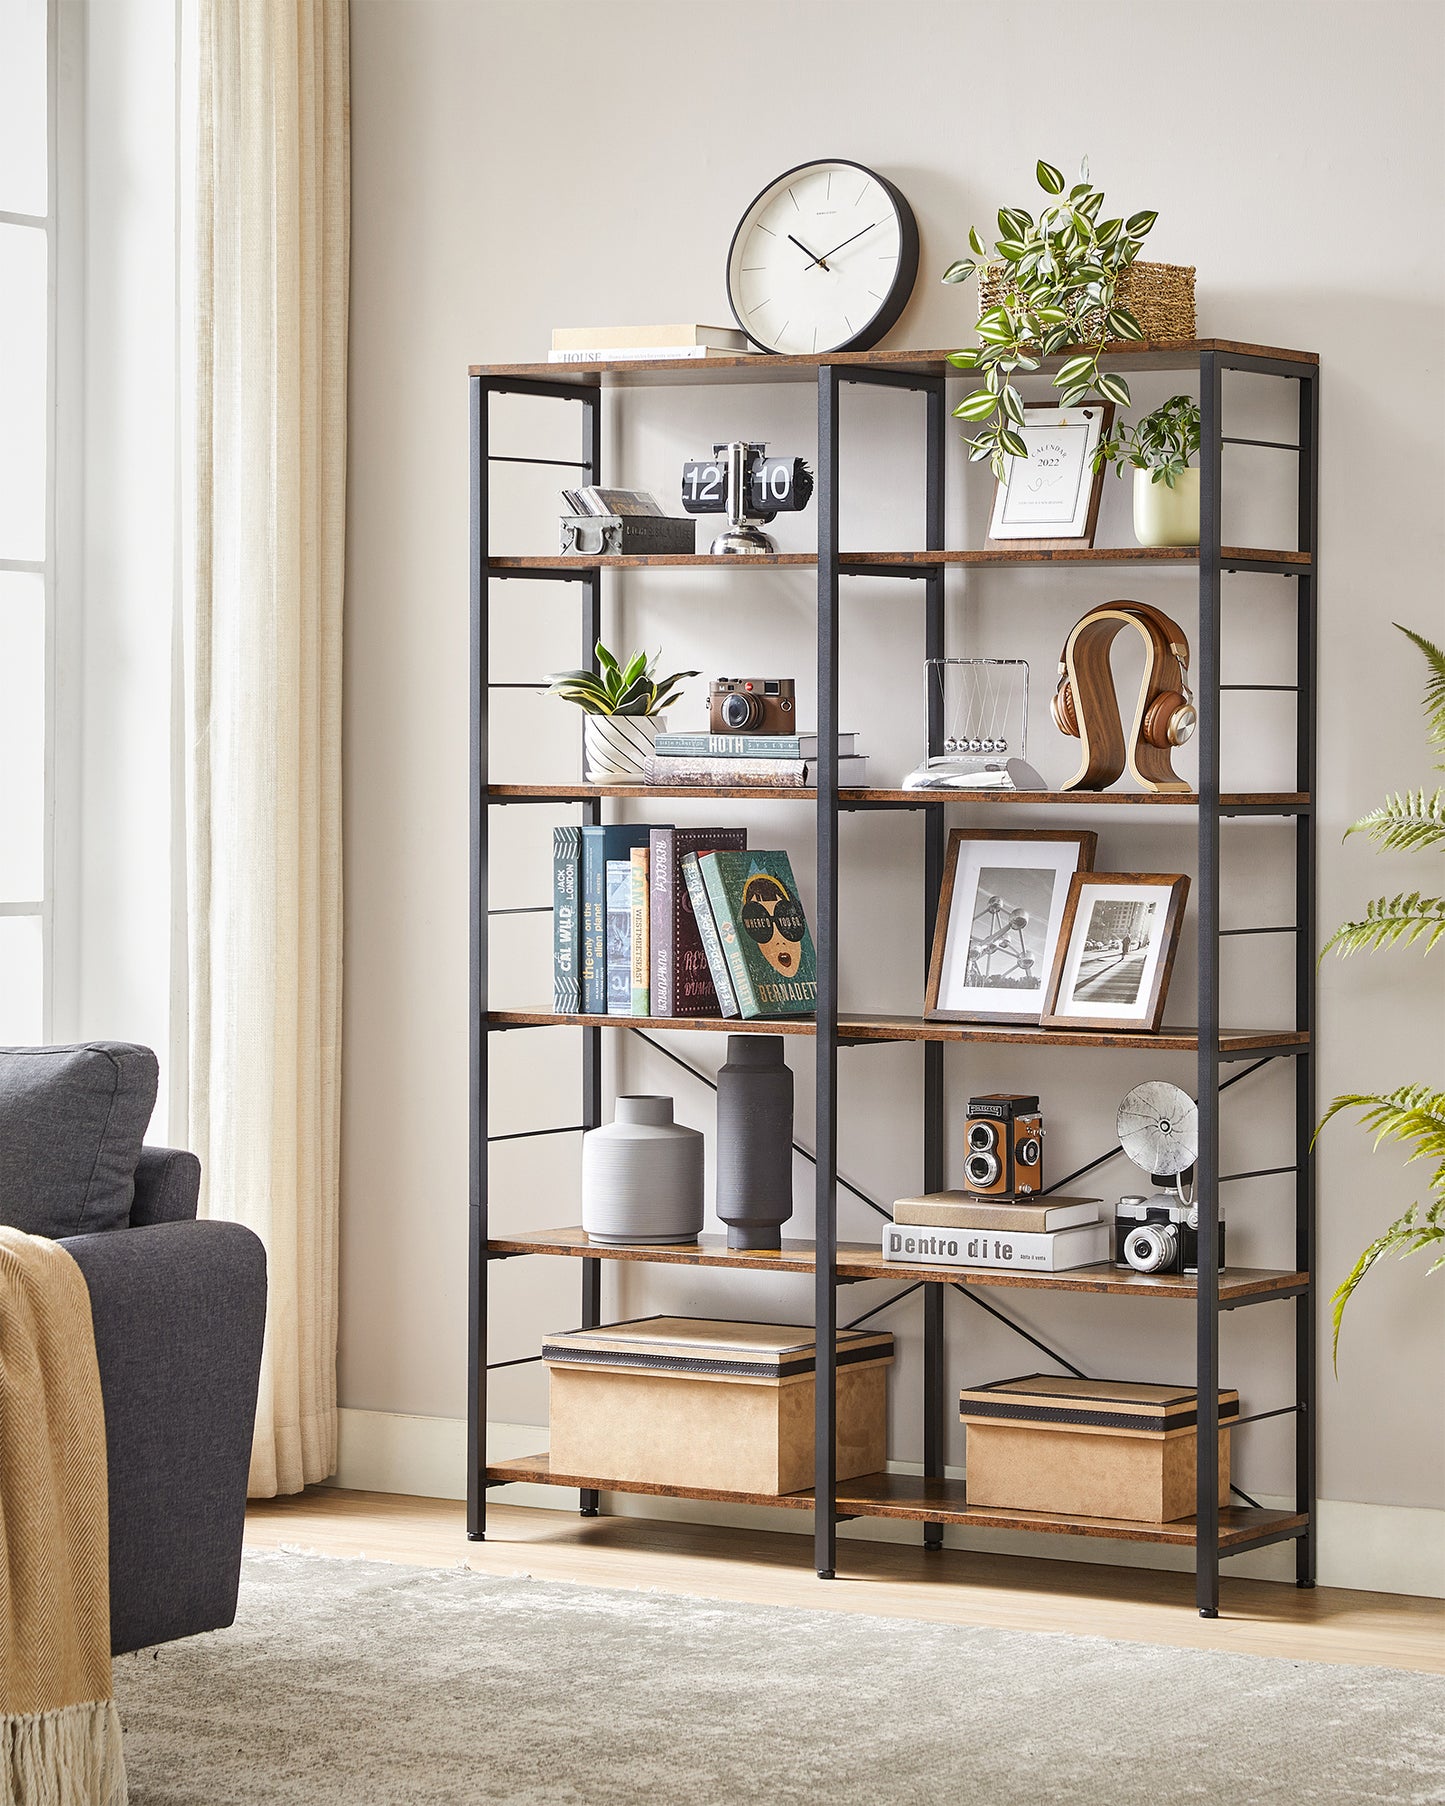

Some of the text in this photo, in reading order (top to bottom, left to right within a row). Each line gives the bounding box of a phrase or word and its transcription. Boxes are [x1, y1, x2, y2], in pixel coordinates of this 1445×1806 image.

[563, 352, 602, 363] HOUSE
[1031, 444, 1067, 459] CALENDAR
[1037, 458, 1060, 467] 2022
[686, 465, 721, 501] 12
[755, 465, 790, 500] 10
[709, 736, 744, 753] HOTH
[655, 840, 667, 893] REBECCA
[557, 869, 566, 893] JACK
[565, 864, 574, 900] LONDON
[583, 902, 592, 917] the
[593, 903, 604, 932] planet
[585, 919, 592, 932] on
[744, 917, 771, 929] WHERE'D
[778, 916, 791, 928] YOU
[594, 935, 603, 958] alien
[583, 937, 595, 980] the only
[758, 981, 817, 1003] BERNADETT
[890, 1233, 1013, 1260] Dentro di te
